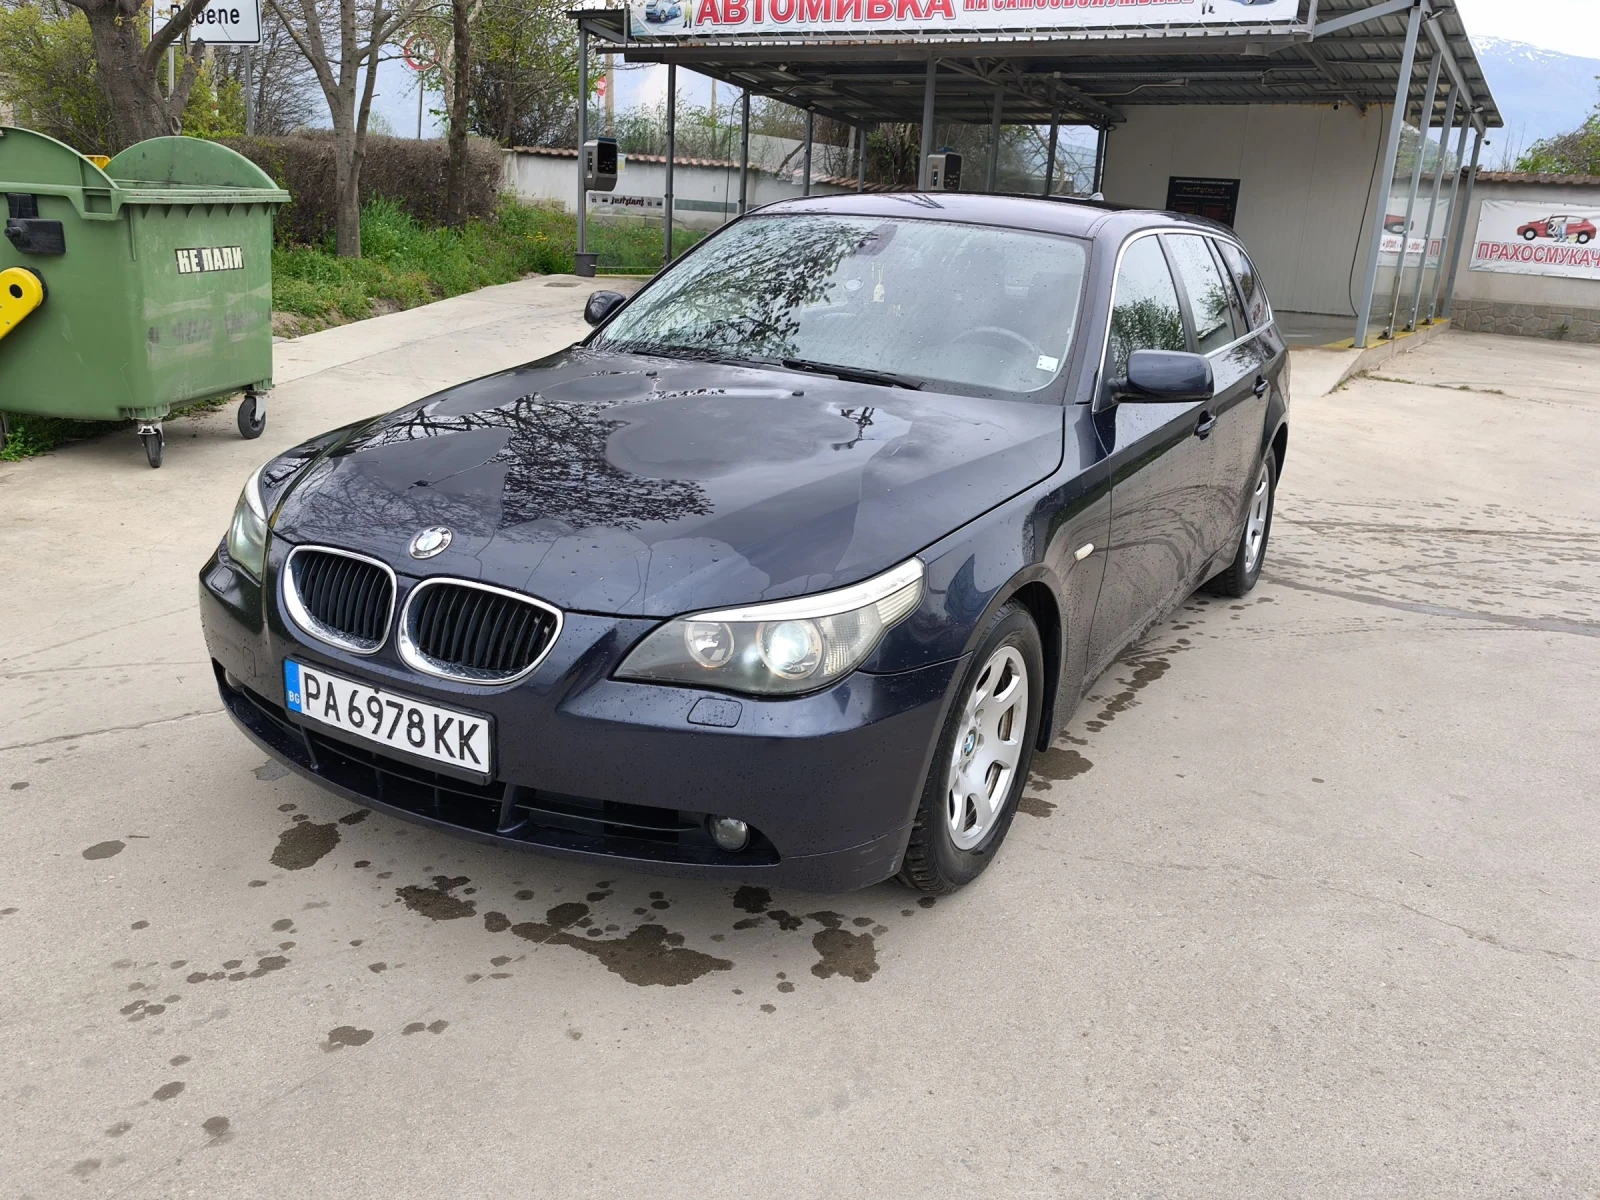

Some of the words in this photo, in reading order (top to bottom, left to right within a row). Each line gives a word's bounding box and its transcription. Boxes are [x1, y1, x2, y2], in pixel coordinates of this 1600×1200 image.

[177, 249, 200, 273] НЕ
[201, 247, 243, 271] ПАЛИ
[289, 691, 300, 704] BG
